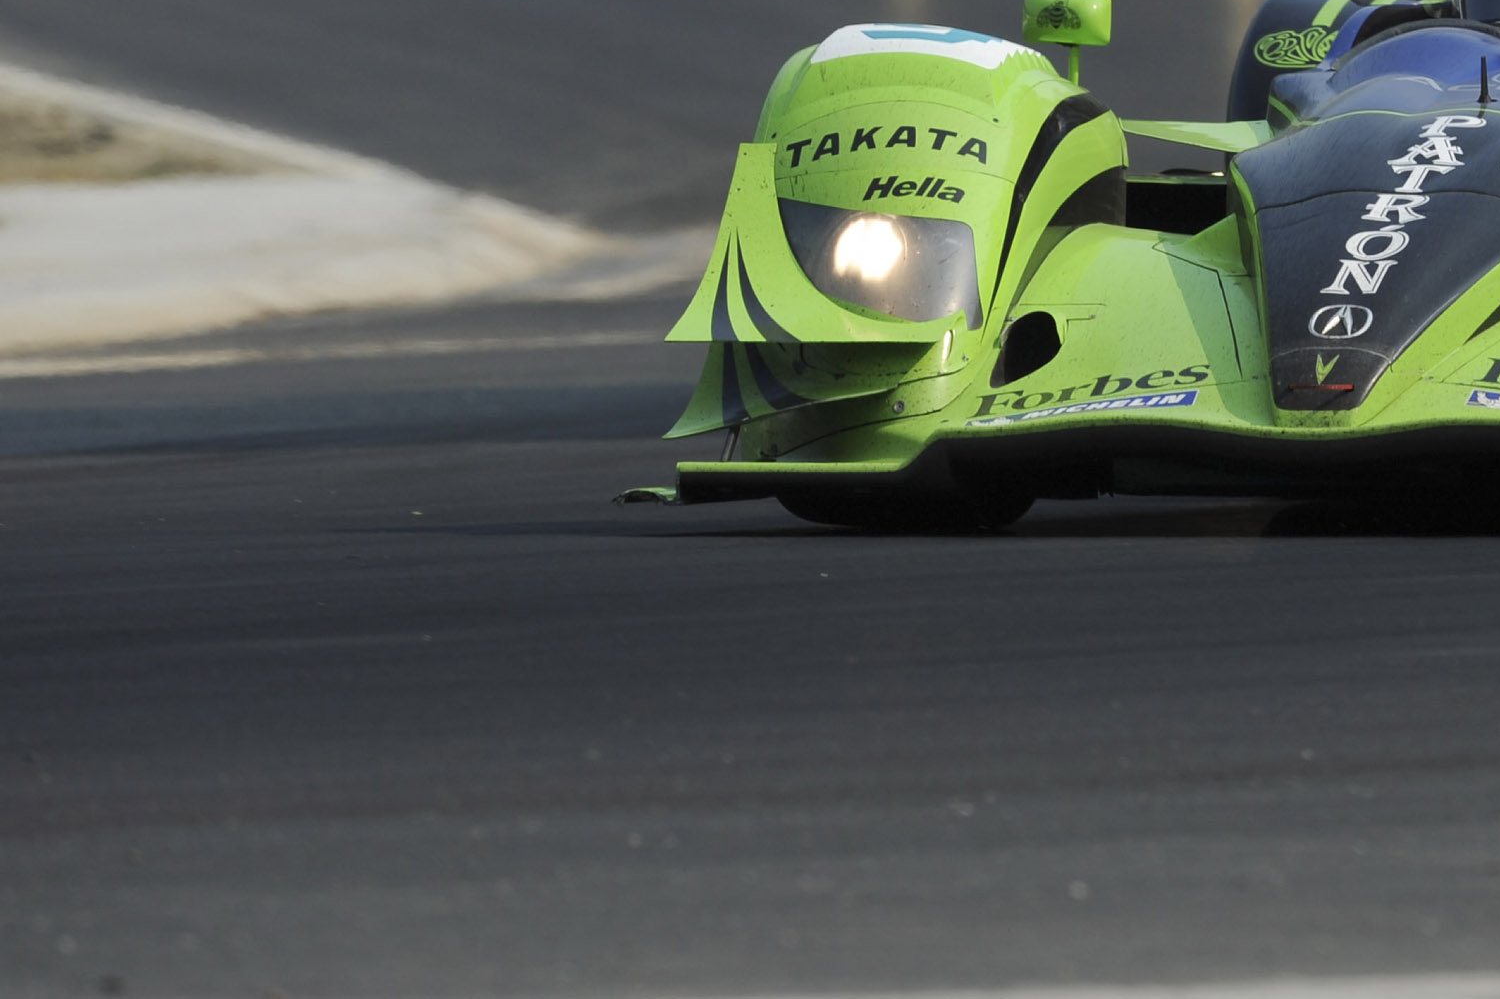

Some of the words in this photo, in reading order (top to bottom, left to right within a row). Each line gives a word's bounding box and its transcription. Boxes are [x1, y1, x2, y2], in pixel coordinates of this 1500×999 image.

[786, 125, 988, 168] TAKATA
[862, 175, 966, 204] Hella
[1319, 115, 1487, 294] PATRÓN
[974, 364, 1210, 418] Forbes
[1021, 393, 1187, 420] MICHELIN
